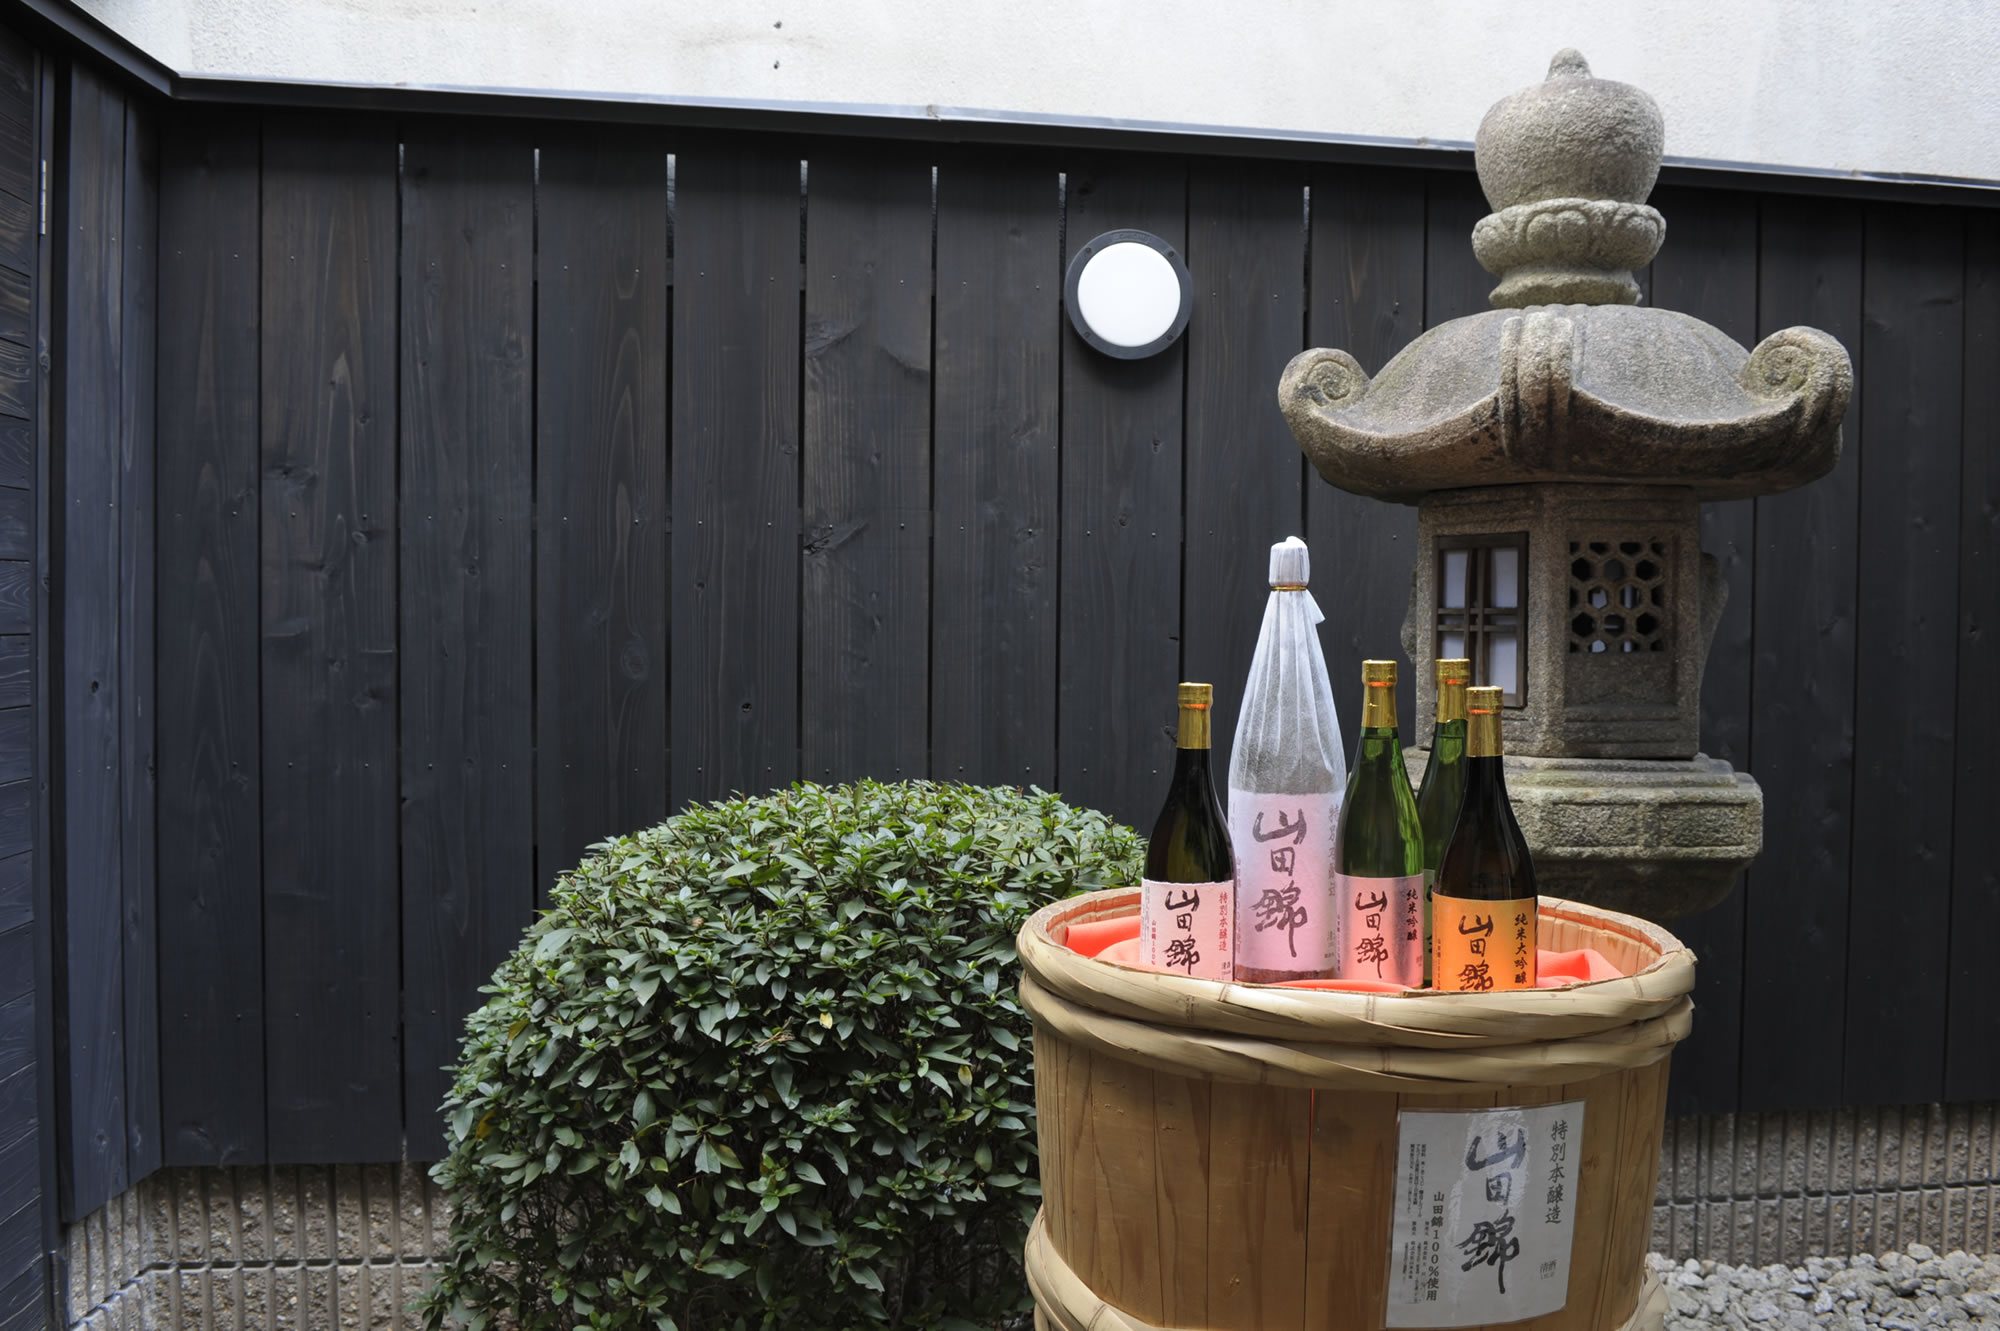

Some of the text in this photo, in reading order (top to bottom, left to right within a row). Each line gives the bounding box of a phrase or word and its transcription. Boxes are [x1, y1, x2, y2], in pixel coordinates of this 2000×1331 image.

[1250, 808, 1308, 958] 山田錦
[1406, 888, 1419, 941] 純米吟醸
[1164, 889, 1200, 975] 山田錦
[1355, 890, 1389, 979] 山田錦
[1514, 912, 1528, 984] 純米大吟醸
[1456, 1128, 1527, 1294] 山田錦
[1545, 1119, 1568, 1225] 特別本醸造
